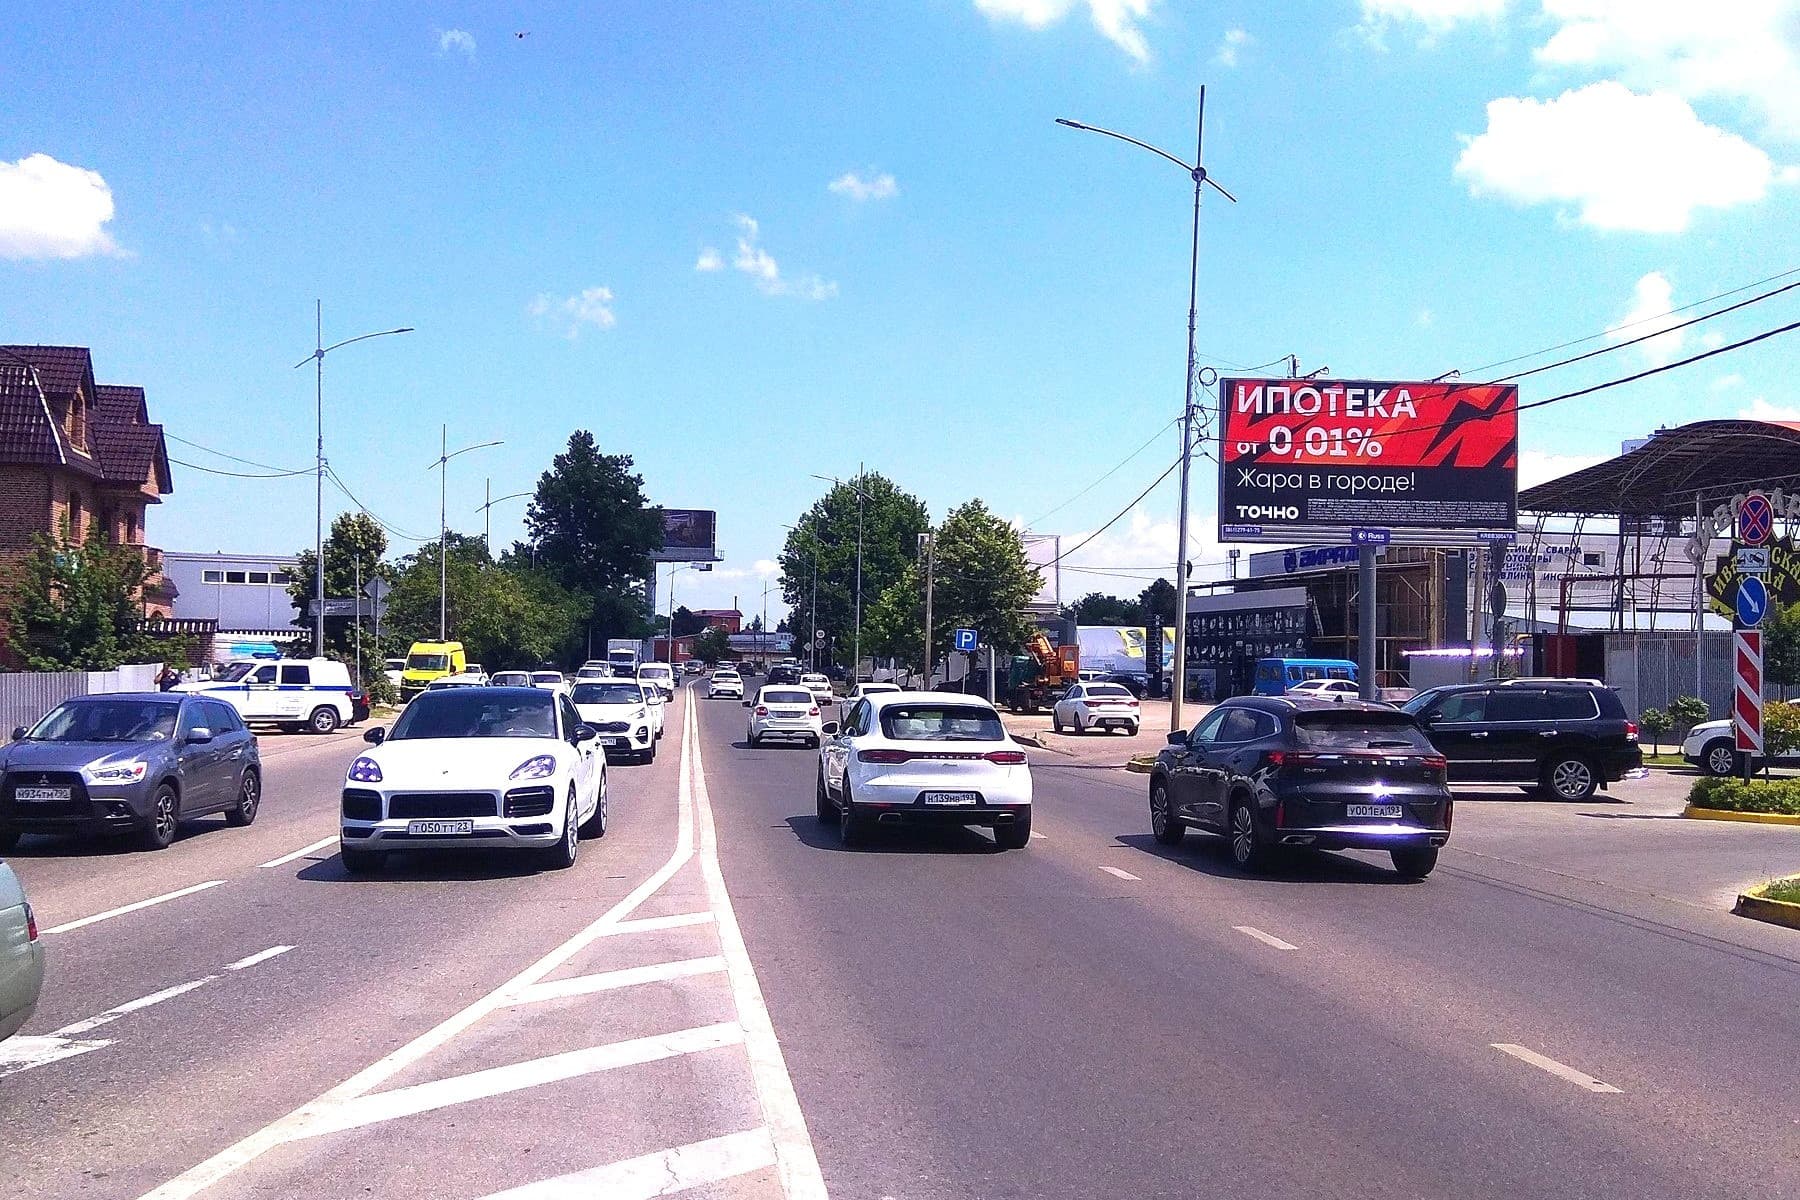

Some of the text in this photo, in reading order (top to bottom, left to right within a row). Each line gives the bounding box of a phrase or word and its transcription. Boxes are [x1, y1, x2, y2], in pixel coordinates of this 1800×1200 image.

[1238, 386, 1417, 418] ИПОТЕКА
[1237, 425, 1383, 459] от 0,01%
[1237, 468, 1415, 495] Жара в городе!
[1236, 505, 1299, 519] ТОЧНО
[1545, 545, 1583, 555] СВАРКА
[962, 632, 973, 648] P
